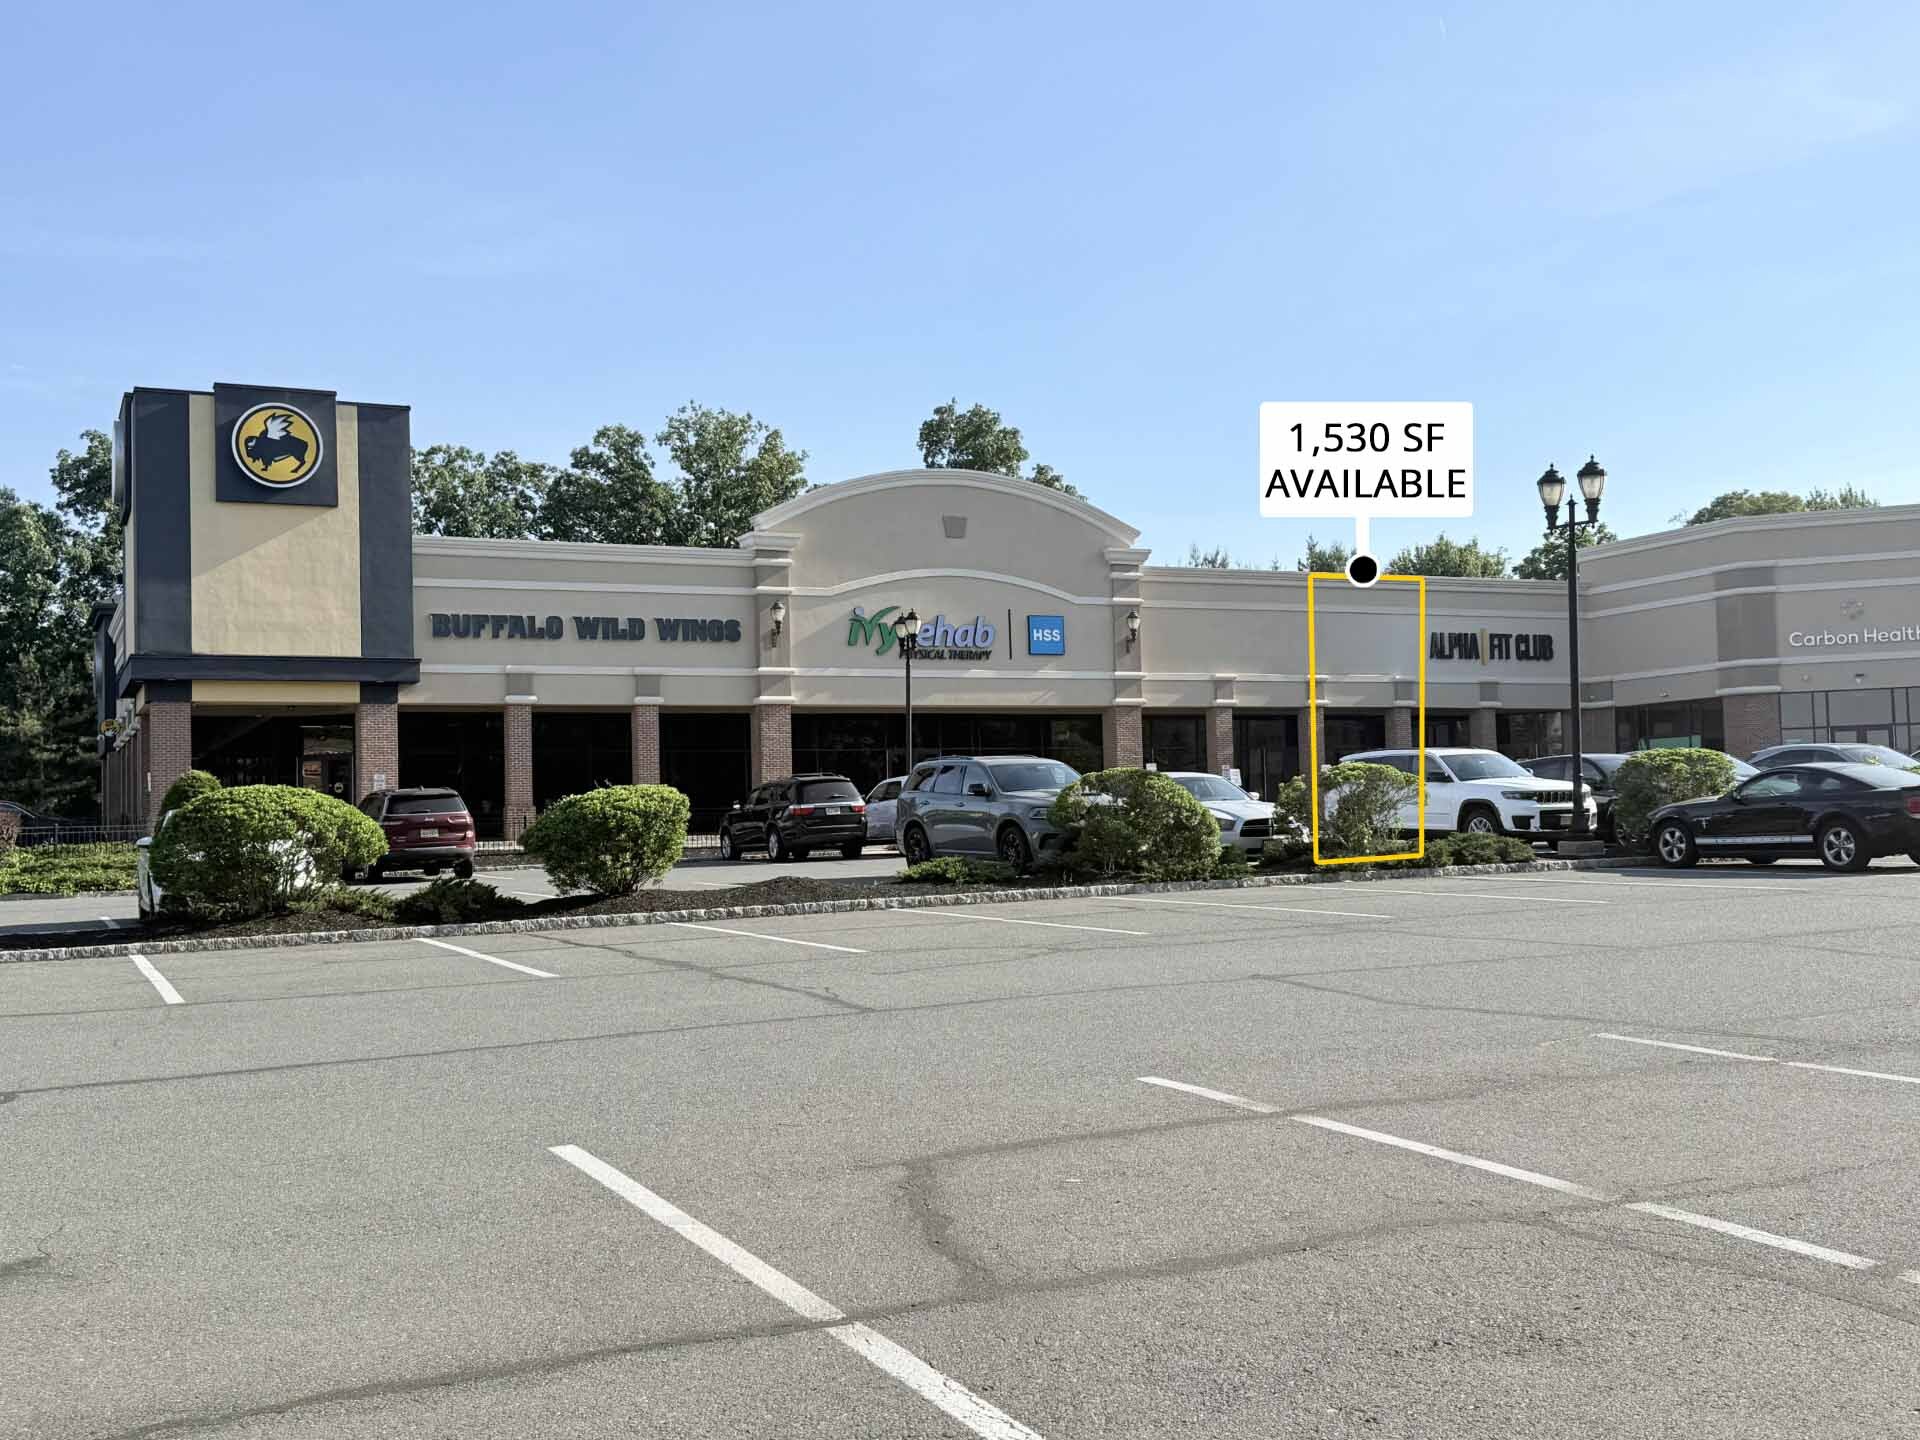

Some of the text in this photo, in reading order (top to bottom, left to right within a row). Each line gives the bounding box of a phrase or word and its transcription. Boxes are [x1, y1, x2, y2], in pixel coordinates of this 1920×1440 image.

[431, 613, 742, 643] BUFFALO WILD WINGS
[1032, 629, 1061, 642] HSS
[1430, 632, 1555, 662] ALPHA FIT CLUB
[1789, 630, 1859, 647] Carbon
[949, 649, 993, 661] THERAPY
